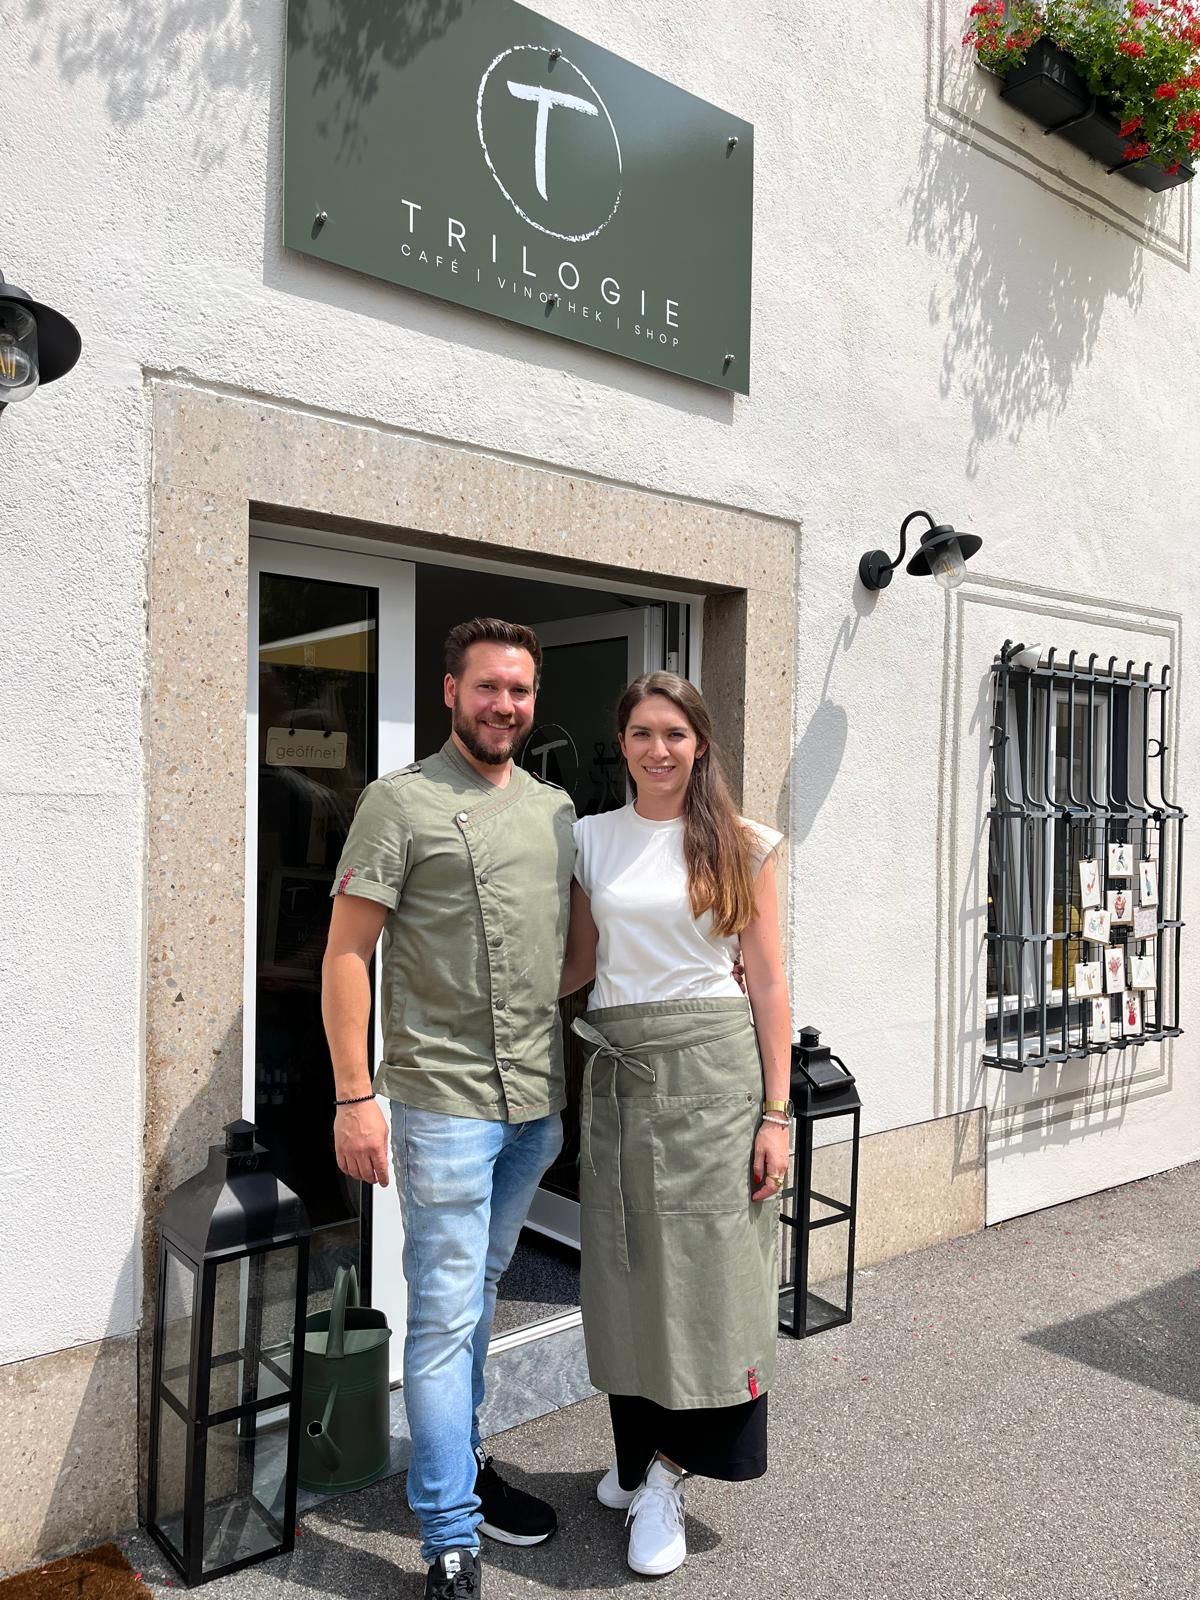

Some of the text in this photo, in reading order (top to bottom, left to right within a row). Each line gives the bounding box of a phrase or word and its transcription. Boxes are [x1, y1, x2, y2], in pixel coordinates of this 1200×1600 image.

[507, 80, 599, 201] T
[401, 199, 679, 328] TRILOGIE
[401, 244, 458, 274] CAFÉ
[498, 276, 602, 323] VINOTHEK
[634, 324, 679, 347] SHOP
[276, 745, 337, 760] geöffnet
[530, 739, 568, 780] T
